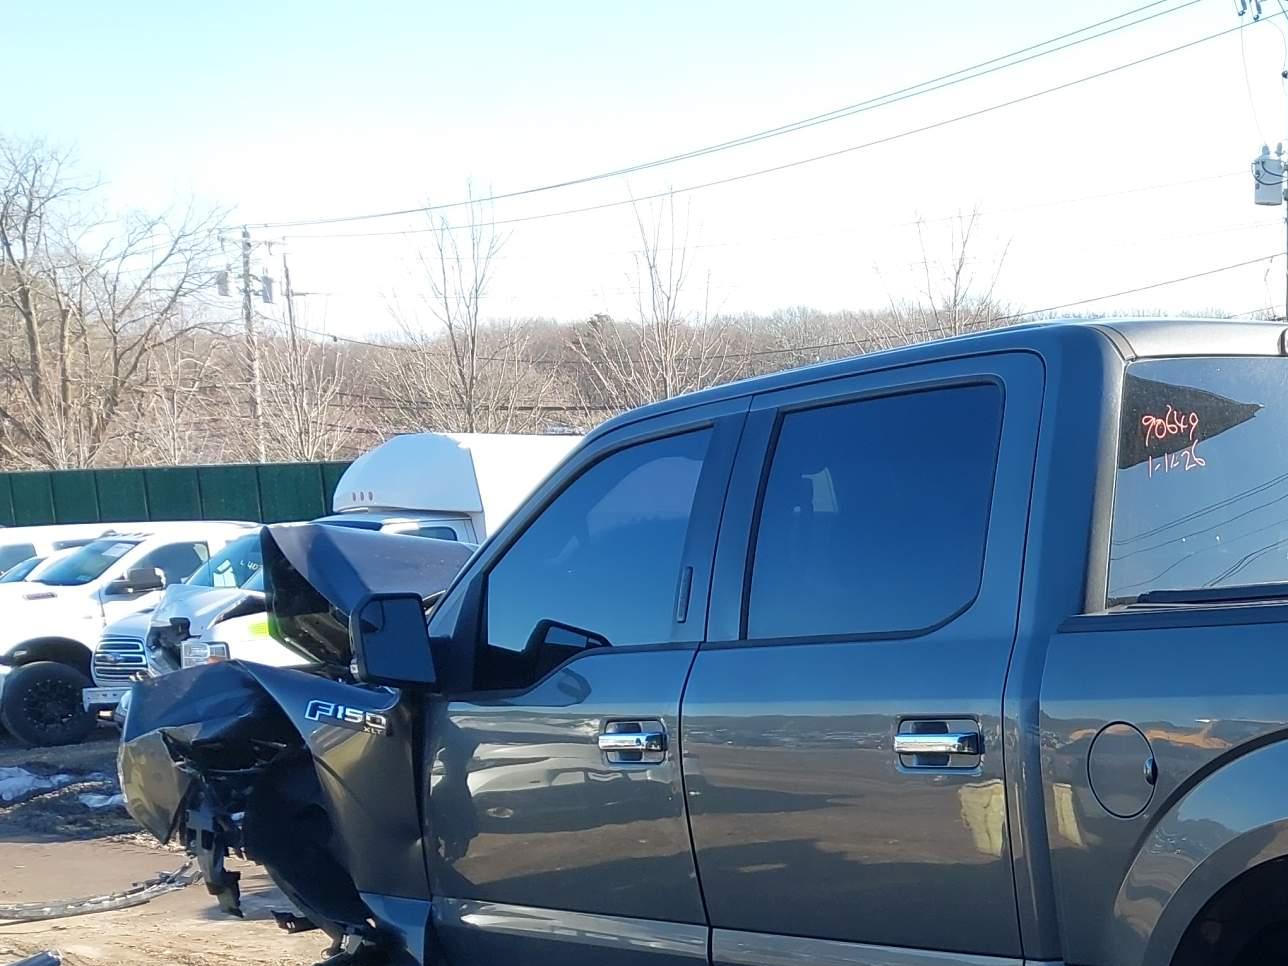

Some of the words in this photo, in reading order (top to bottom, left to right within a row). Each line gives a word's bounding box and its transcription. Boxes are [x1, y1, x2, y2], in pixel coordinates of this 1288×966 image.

[1142, 404, 1199, 447] 90649
[304, 699, 387, 730] F150
[363, 726, 383, 735] XLT
